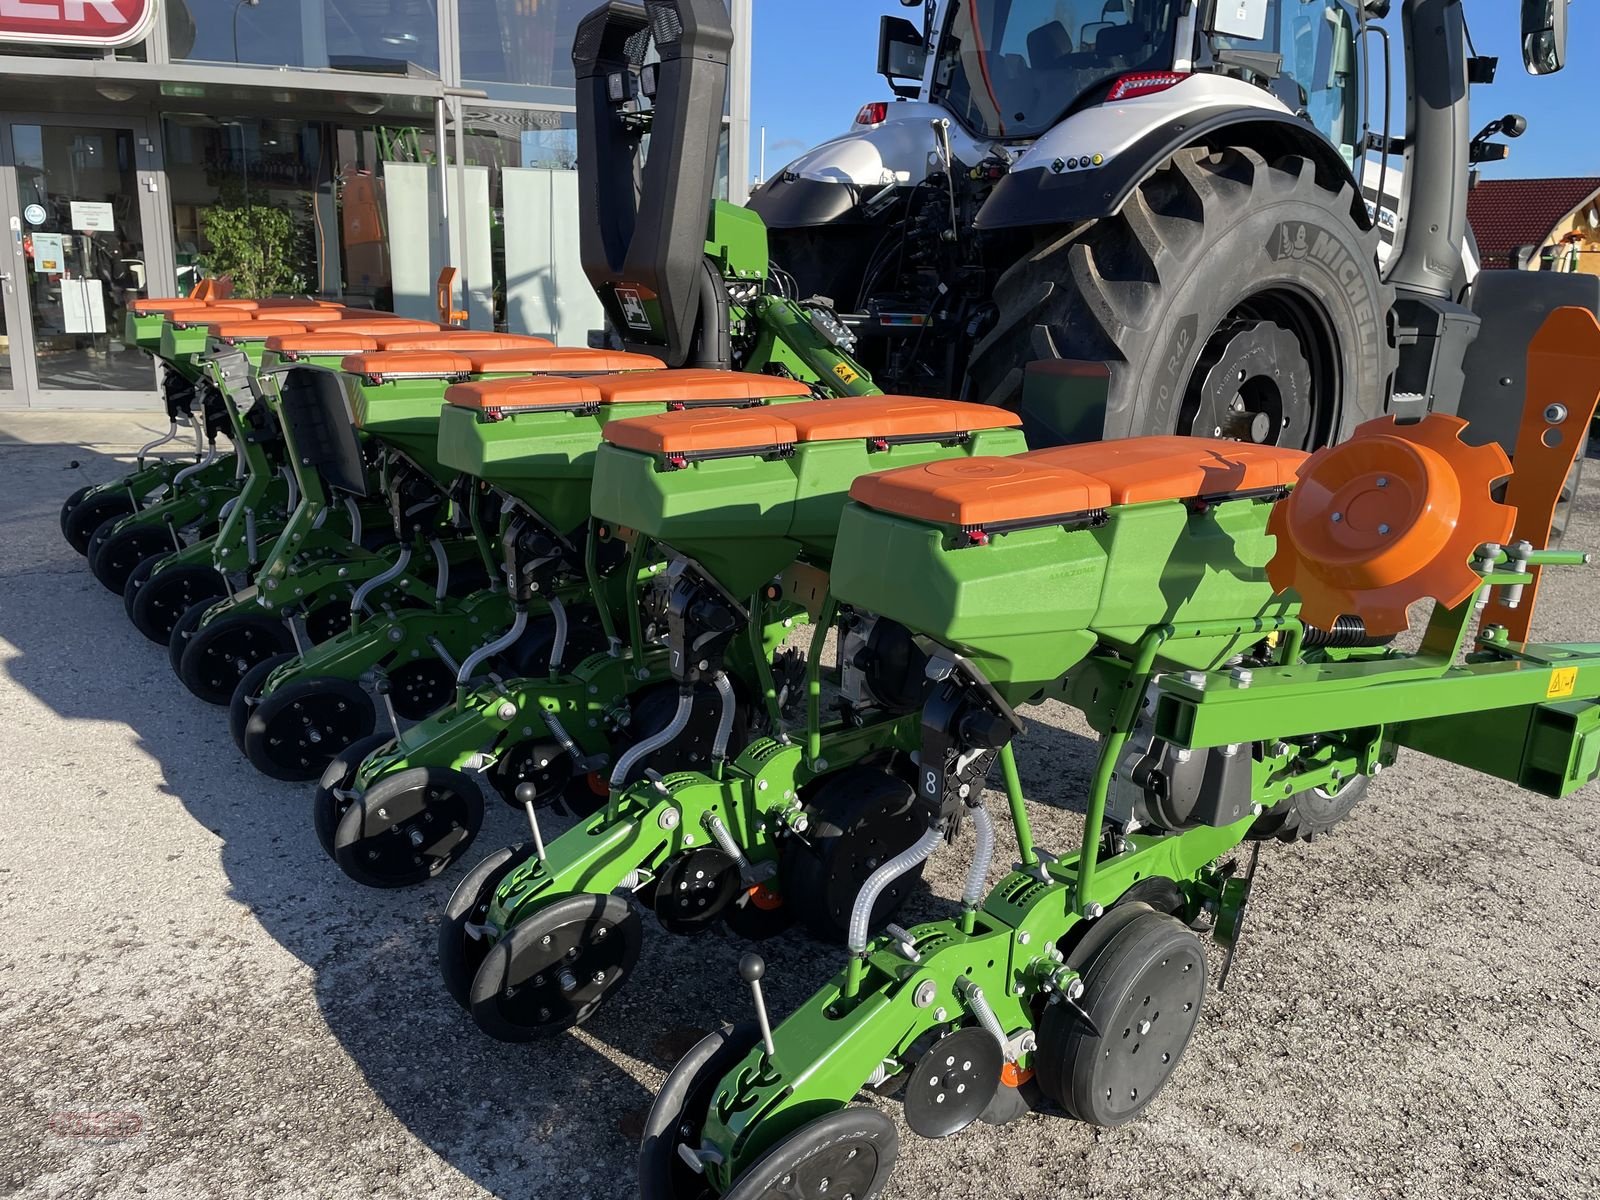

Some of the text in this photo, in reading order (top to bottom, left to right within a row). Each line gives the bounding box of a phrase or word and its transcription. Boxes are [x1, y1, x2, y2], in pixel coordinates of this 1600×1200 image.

[1167, 328, 1190, 376] R42
[509, 573, 514, 589] 6
[673, 650, 680, 668] 7
[925, 771, 936, 794] 8
